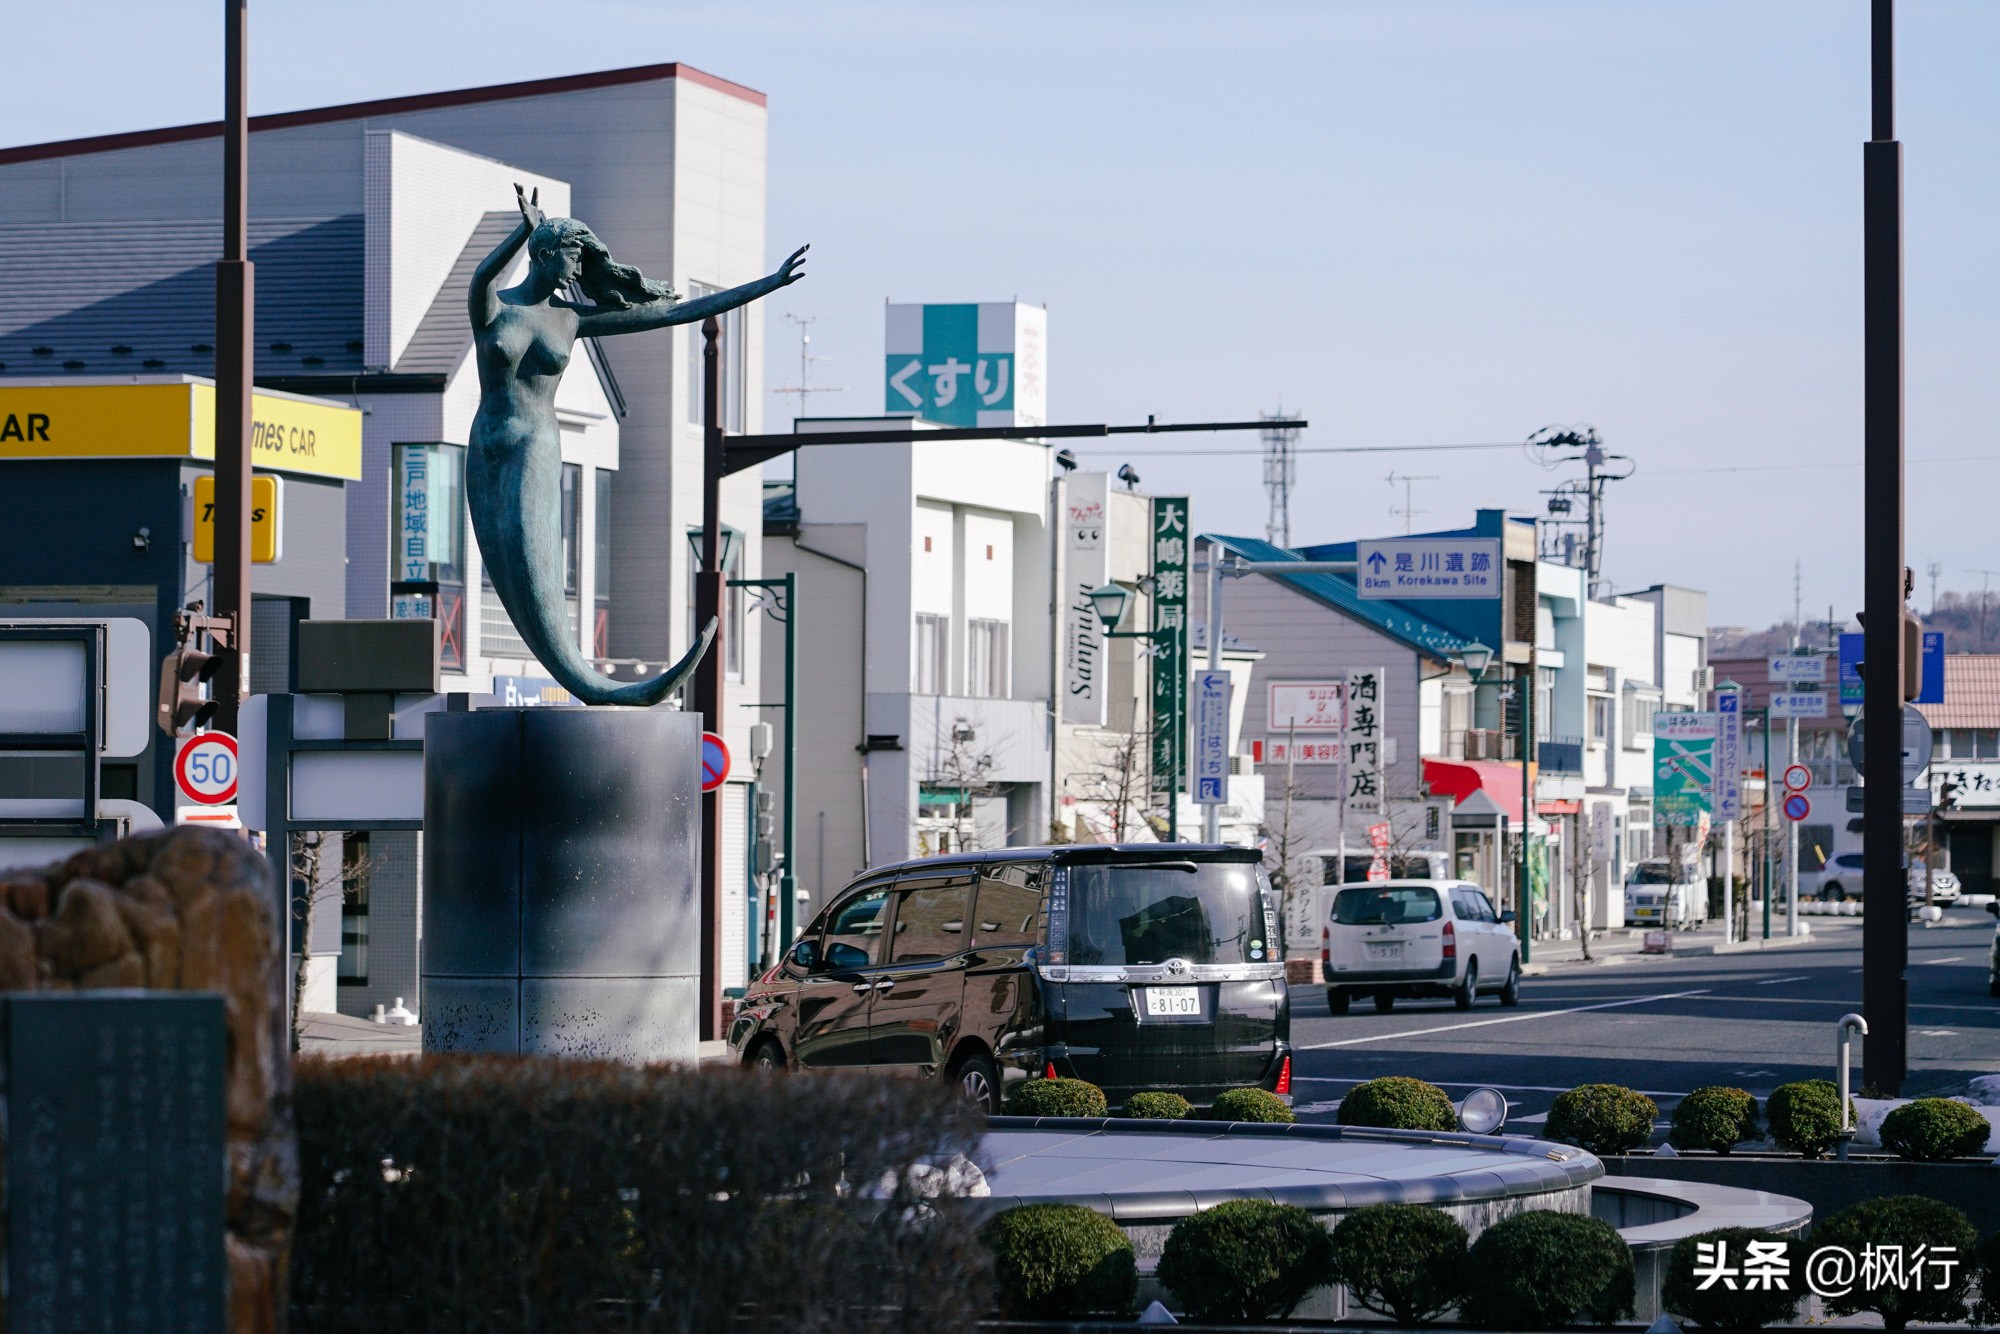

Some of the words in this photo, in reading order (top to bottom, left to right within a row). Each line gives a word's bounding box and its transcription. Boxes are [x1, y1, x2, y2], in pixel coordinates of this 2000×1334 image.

[889, 357, 1009, 408] くすり
[0, 413, 50, 442] AR
[252, 419, 285, 453] mes
[289, 427, 316, 457] CAR
[1395, 552, 1490, 572] 是川遺跡
[1365, 578, 1390, 589] 8km
[1398, 575, 1458, 586] Korekawa
[1463, 574, 1487, 586] Site
[1071, 583, 1098, 699] Sanpuku
[1350, 673, 1378, 798] 酒専門店
[192, 753, 231, 784] 50
[1208, 735, 1222, 774] はっち
[1789, 771, 1807, 785] 50
[1159, 997, 1195, 1013] 81-07
